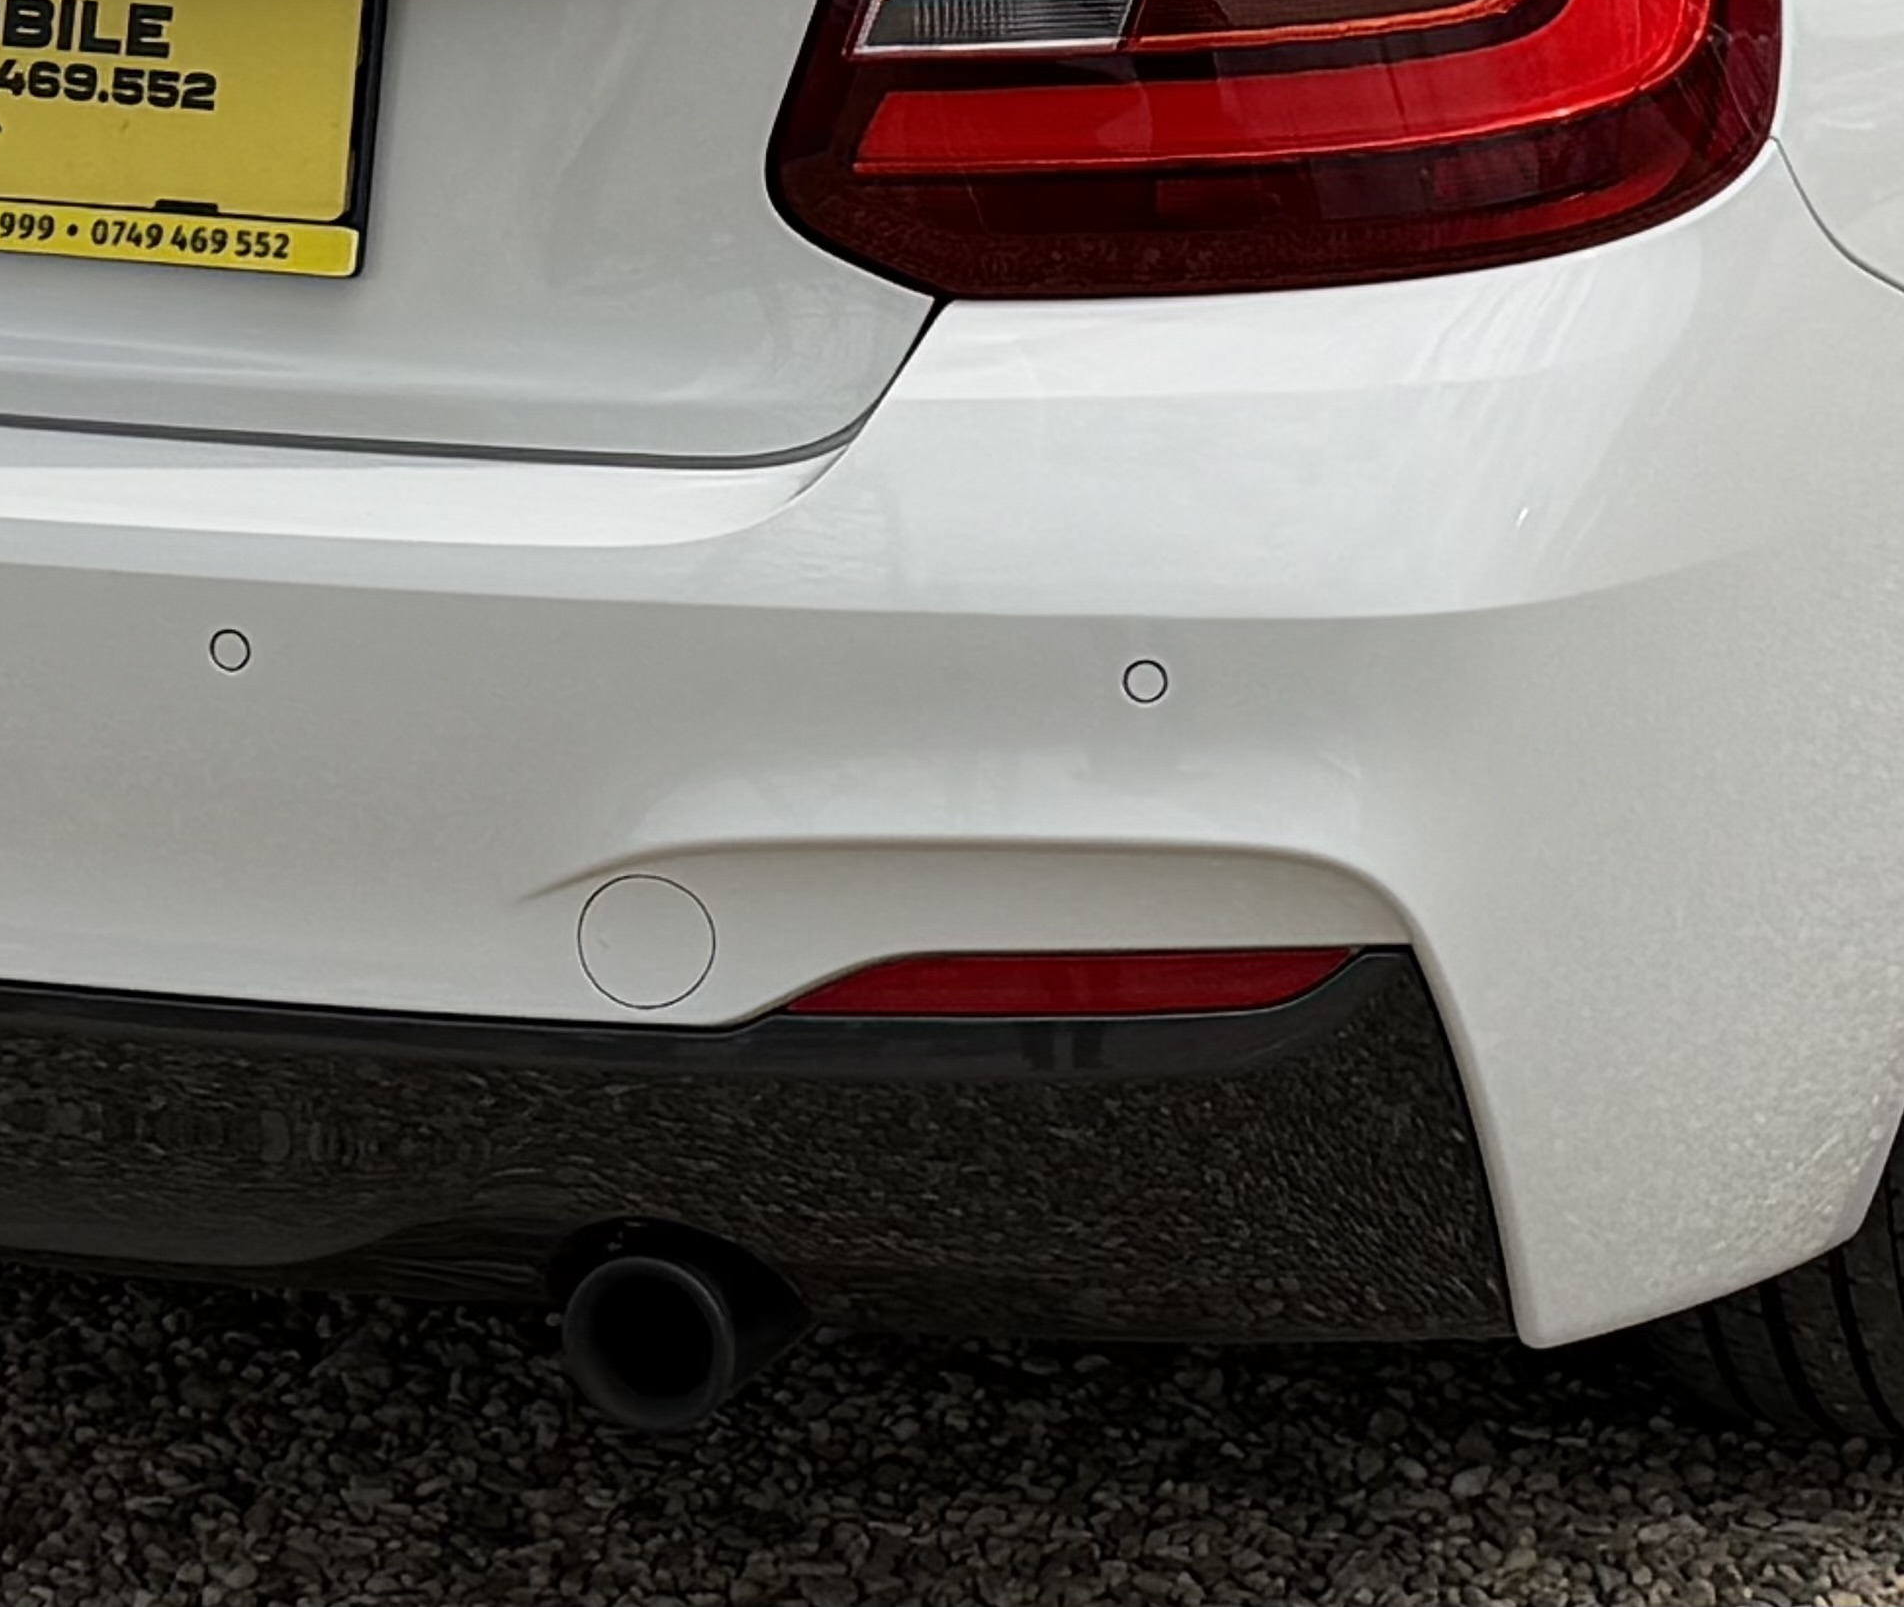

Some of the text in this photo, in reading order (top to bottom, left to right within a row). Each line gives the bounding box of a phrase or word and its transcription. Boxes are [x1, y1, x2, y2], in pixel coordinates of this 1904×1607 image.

[90, 218, 163, 249] 0749
[170, 224, 228, 255] 469
[234, 229, 291, 260] 552
